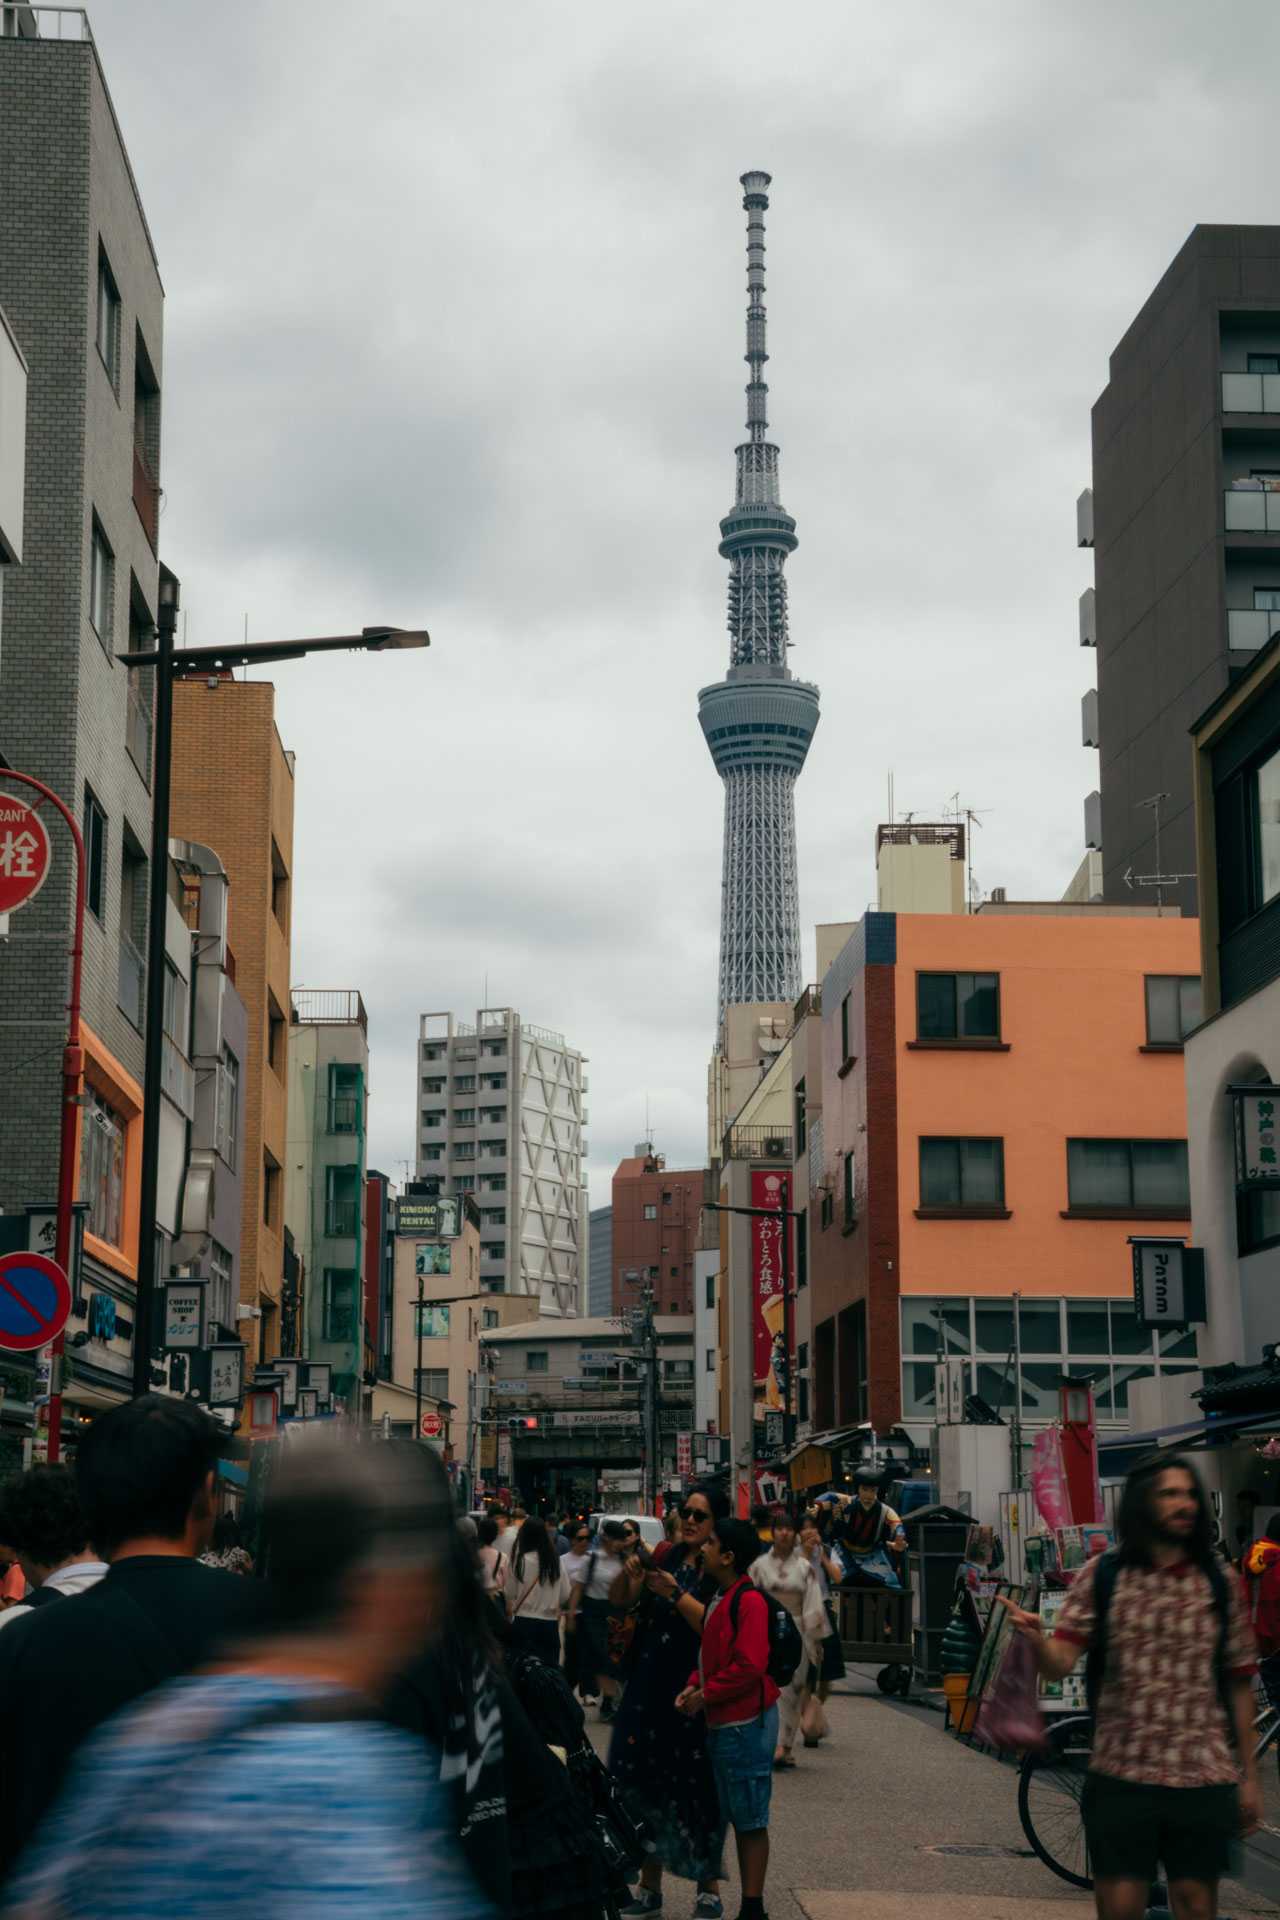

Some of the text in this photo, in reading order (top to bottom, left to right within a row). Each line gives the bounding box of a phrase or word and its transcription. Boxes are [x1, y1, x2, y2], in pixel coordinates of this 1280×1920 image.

[0, 831, 39, 877] 栓
[1249, 1166, 1280, 1179] ヴェニ
[399, 1205, 437, 1214] KIMONO
[400, 1217, 436, 1225] RENTAL
[759, 1217, 773, 1295] ふわとろ食感
[168, 1298, 199, 1306] COFFEE
[172, 1306, 195, 1314] SHOP
